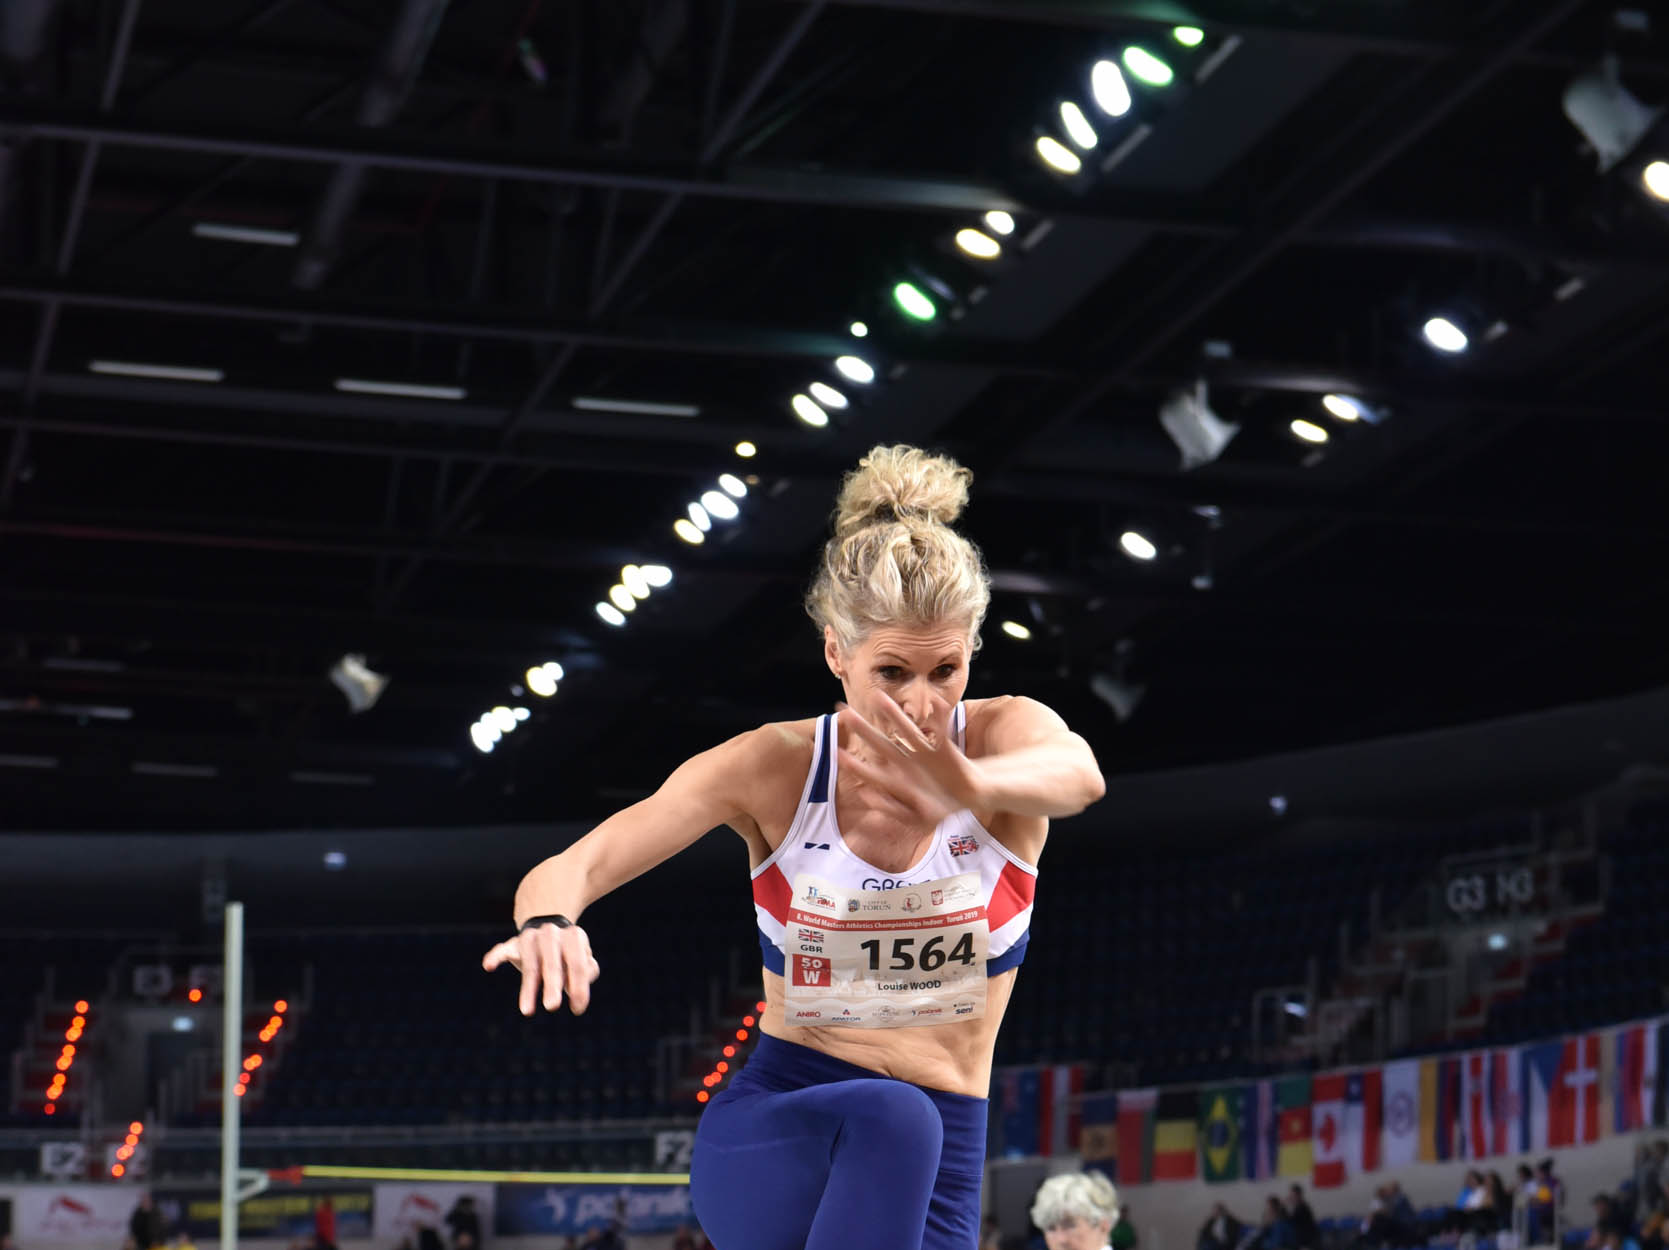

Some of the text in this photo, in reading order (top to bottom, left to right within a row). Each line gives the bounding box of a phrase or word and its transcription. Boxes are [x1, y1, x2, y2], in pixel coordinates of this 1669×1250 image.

[803, 914, 821, 925] World
[821, 918, 845, 928] Masters
[845, 921, 873, 929] Athletics
[874, 920, 922, 929] Championships
[922, 918, 944, 927] Indoor
[964, 910, 979, 920] 2019
[800, 944, 823, 953] GBR
[860, 932, 976, 972] 1564
[801, 957, 823, 969] 50
[803, 970, 821, 985] W
[877, 979, 942, 991] Louise WOOD
